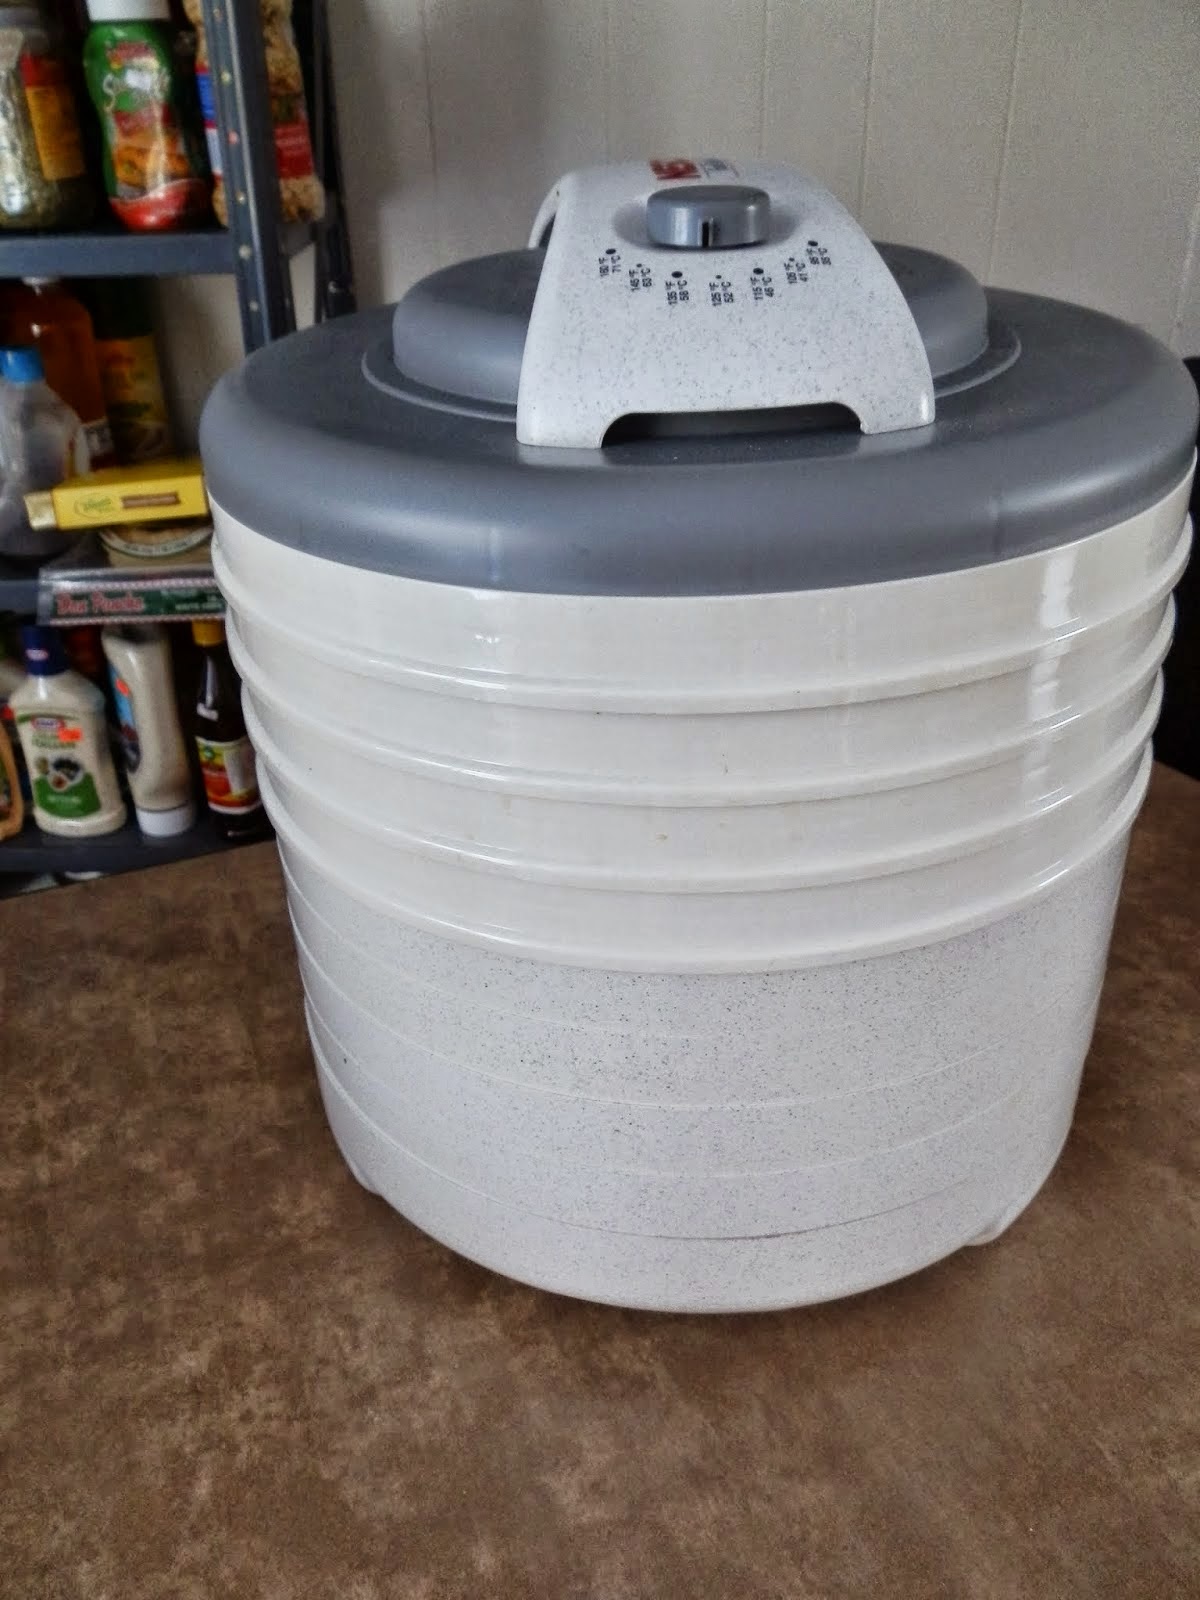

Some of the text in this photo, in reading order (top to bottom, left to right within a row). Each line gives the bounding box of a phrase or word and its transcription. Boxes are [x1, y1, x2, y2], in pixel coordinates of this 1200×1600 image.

[666, 291, 678, 306] 135
[710, 292, 722, 307] 125
[723, 292, 734, 303] 52
[752, 287, 764, 301] 115
